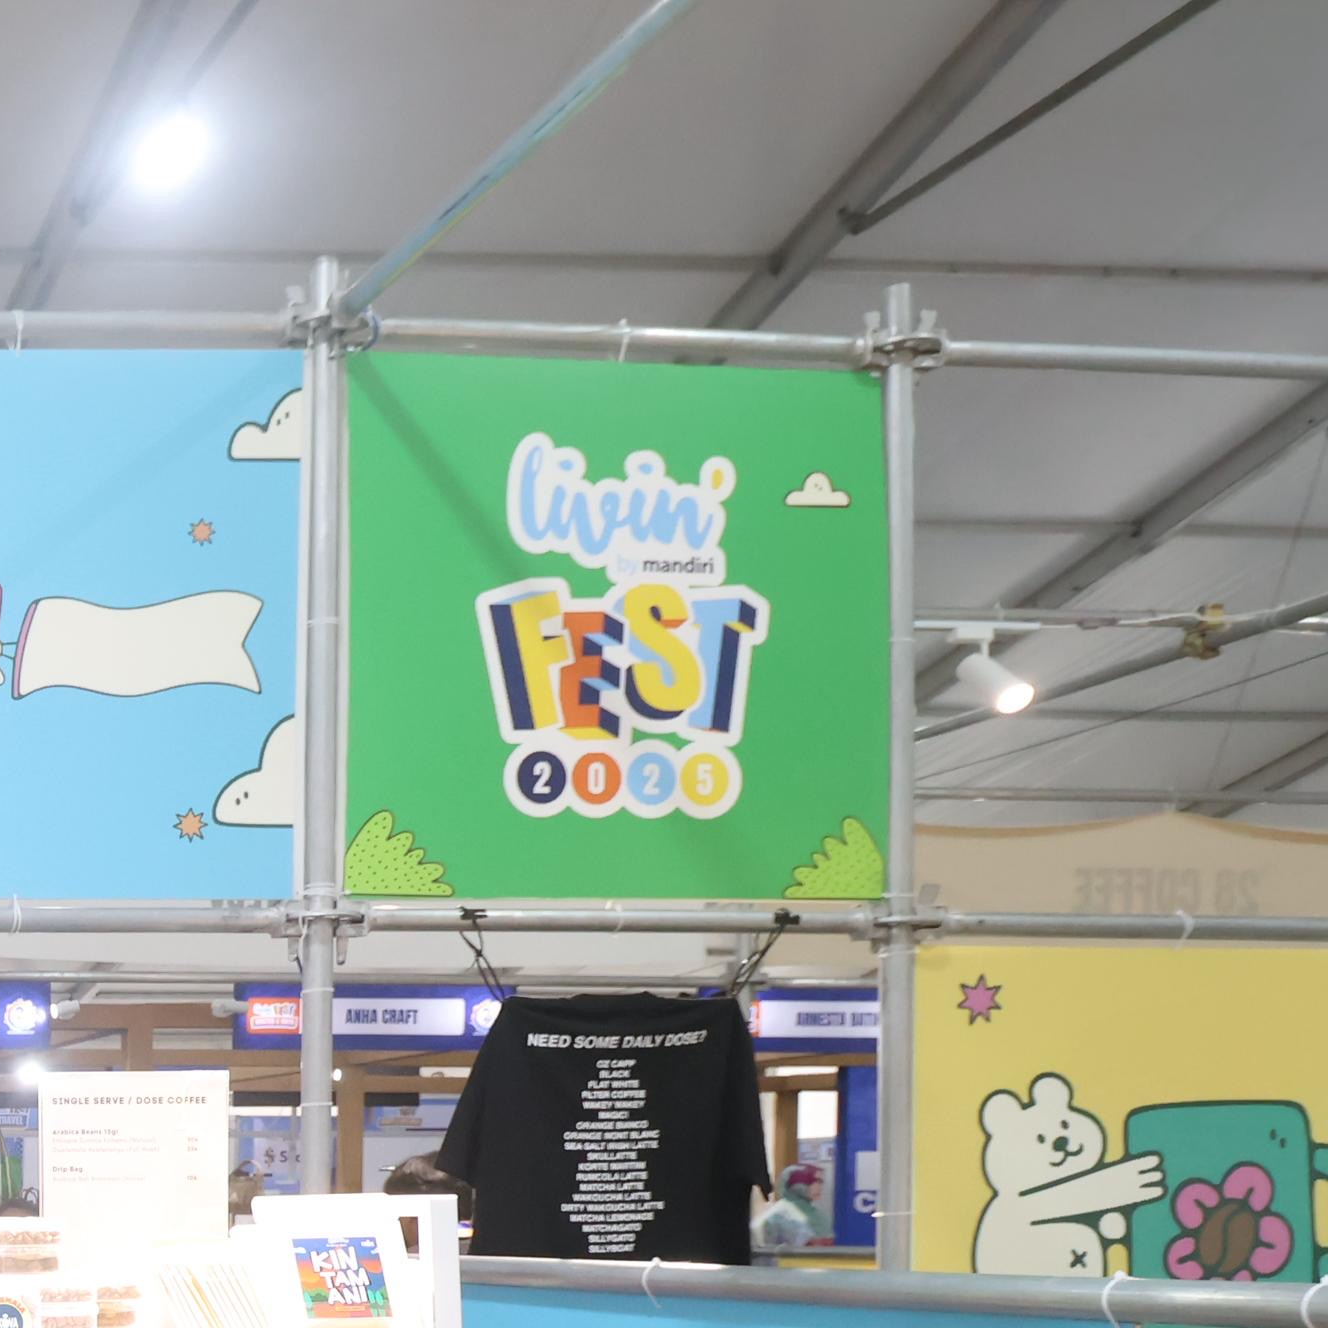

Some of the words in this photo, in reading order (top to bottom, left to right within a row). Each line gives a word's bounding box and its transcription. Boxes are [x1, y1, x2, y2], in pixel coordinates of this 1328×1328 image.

[643, 556, 715, 575] mandiri
[489, 583, 757, 740] FEST
[526, 756, 722, 800] 2025
[345, 1008, 378, 1025] ANHA
[381, 1008, 418, 1025] CRAFT
[527, 1033, 571, 1048] NEED
[573, 1035, 621, 1049] SOME
[622, 1034, 665, 1049] DAILY
[664, 1030, 708, 1046] DOSE?
[598, 1069, 631, 1079] BLACK
[587, 1080, 610, 1089] FLAT
[611, 1079, 640, 1089] WHITE
[581, 1090, 610, 1099] FILTER
[611, 1089, 647, 1099] COFFEE
[52, 1097, 90, 1105] SINGLE
[94, 1096, 125, 1105] SERVE
[136, 1096, 164, 1105] DOSE
[167, 1096, 207, 1105] COFFEE
[575, 1121, 615, 1130] ORANGE
[563, 1131, 603, 1140] ORANGE
[620, 1171, 648, 1180] LATTE
[579, 1182, 616, 1191] MATCHA
[617, 1181, 645, 1191] LATTE
[624, 1191, 652, 1201] LATTE
[636, 1200, 665, 1210] LATTE
[569, 1213, 606, 1223] MATCHA
[309, 1246, 359, 1273] KIN
[319, 1267, 371, 1289] TAM
[327, 1285, 369, 1305] ANI
